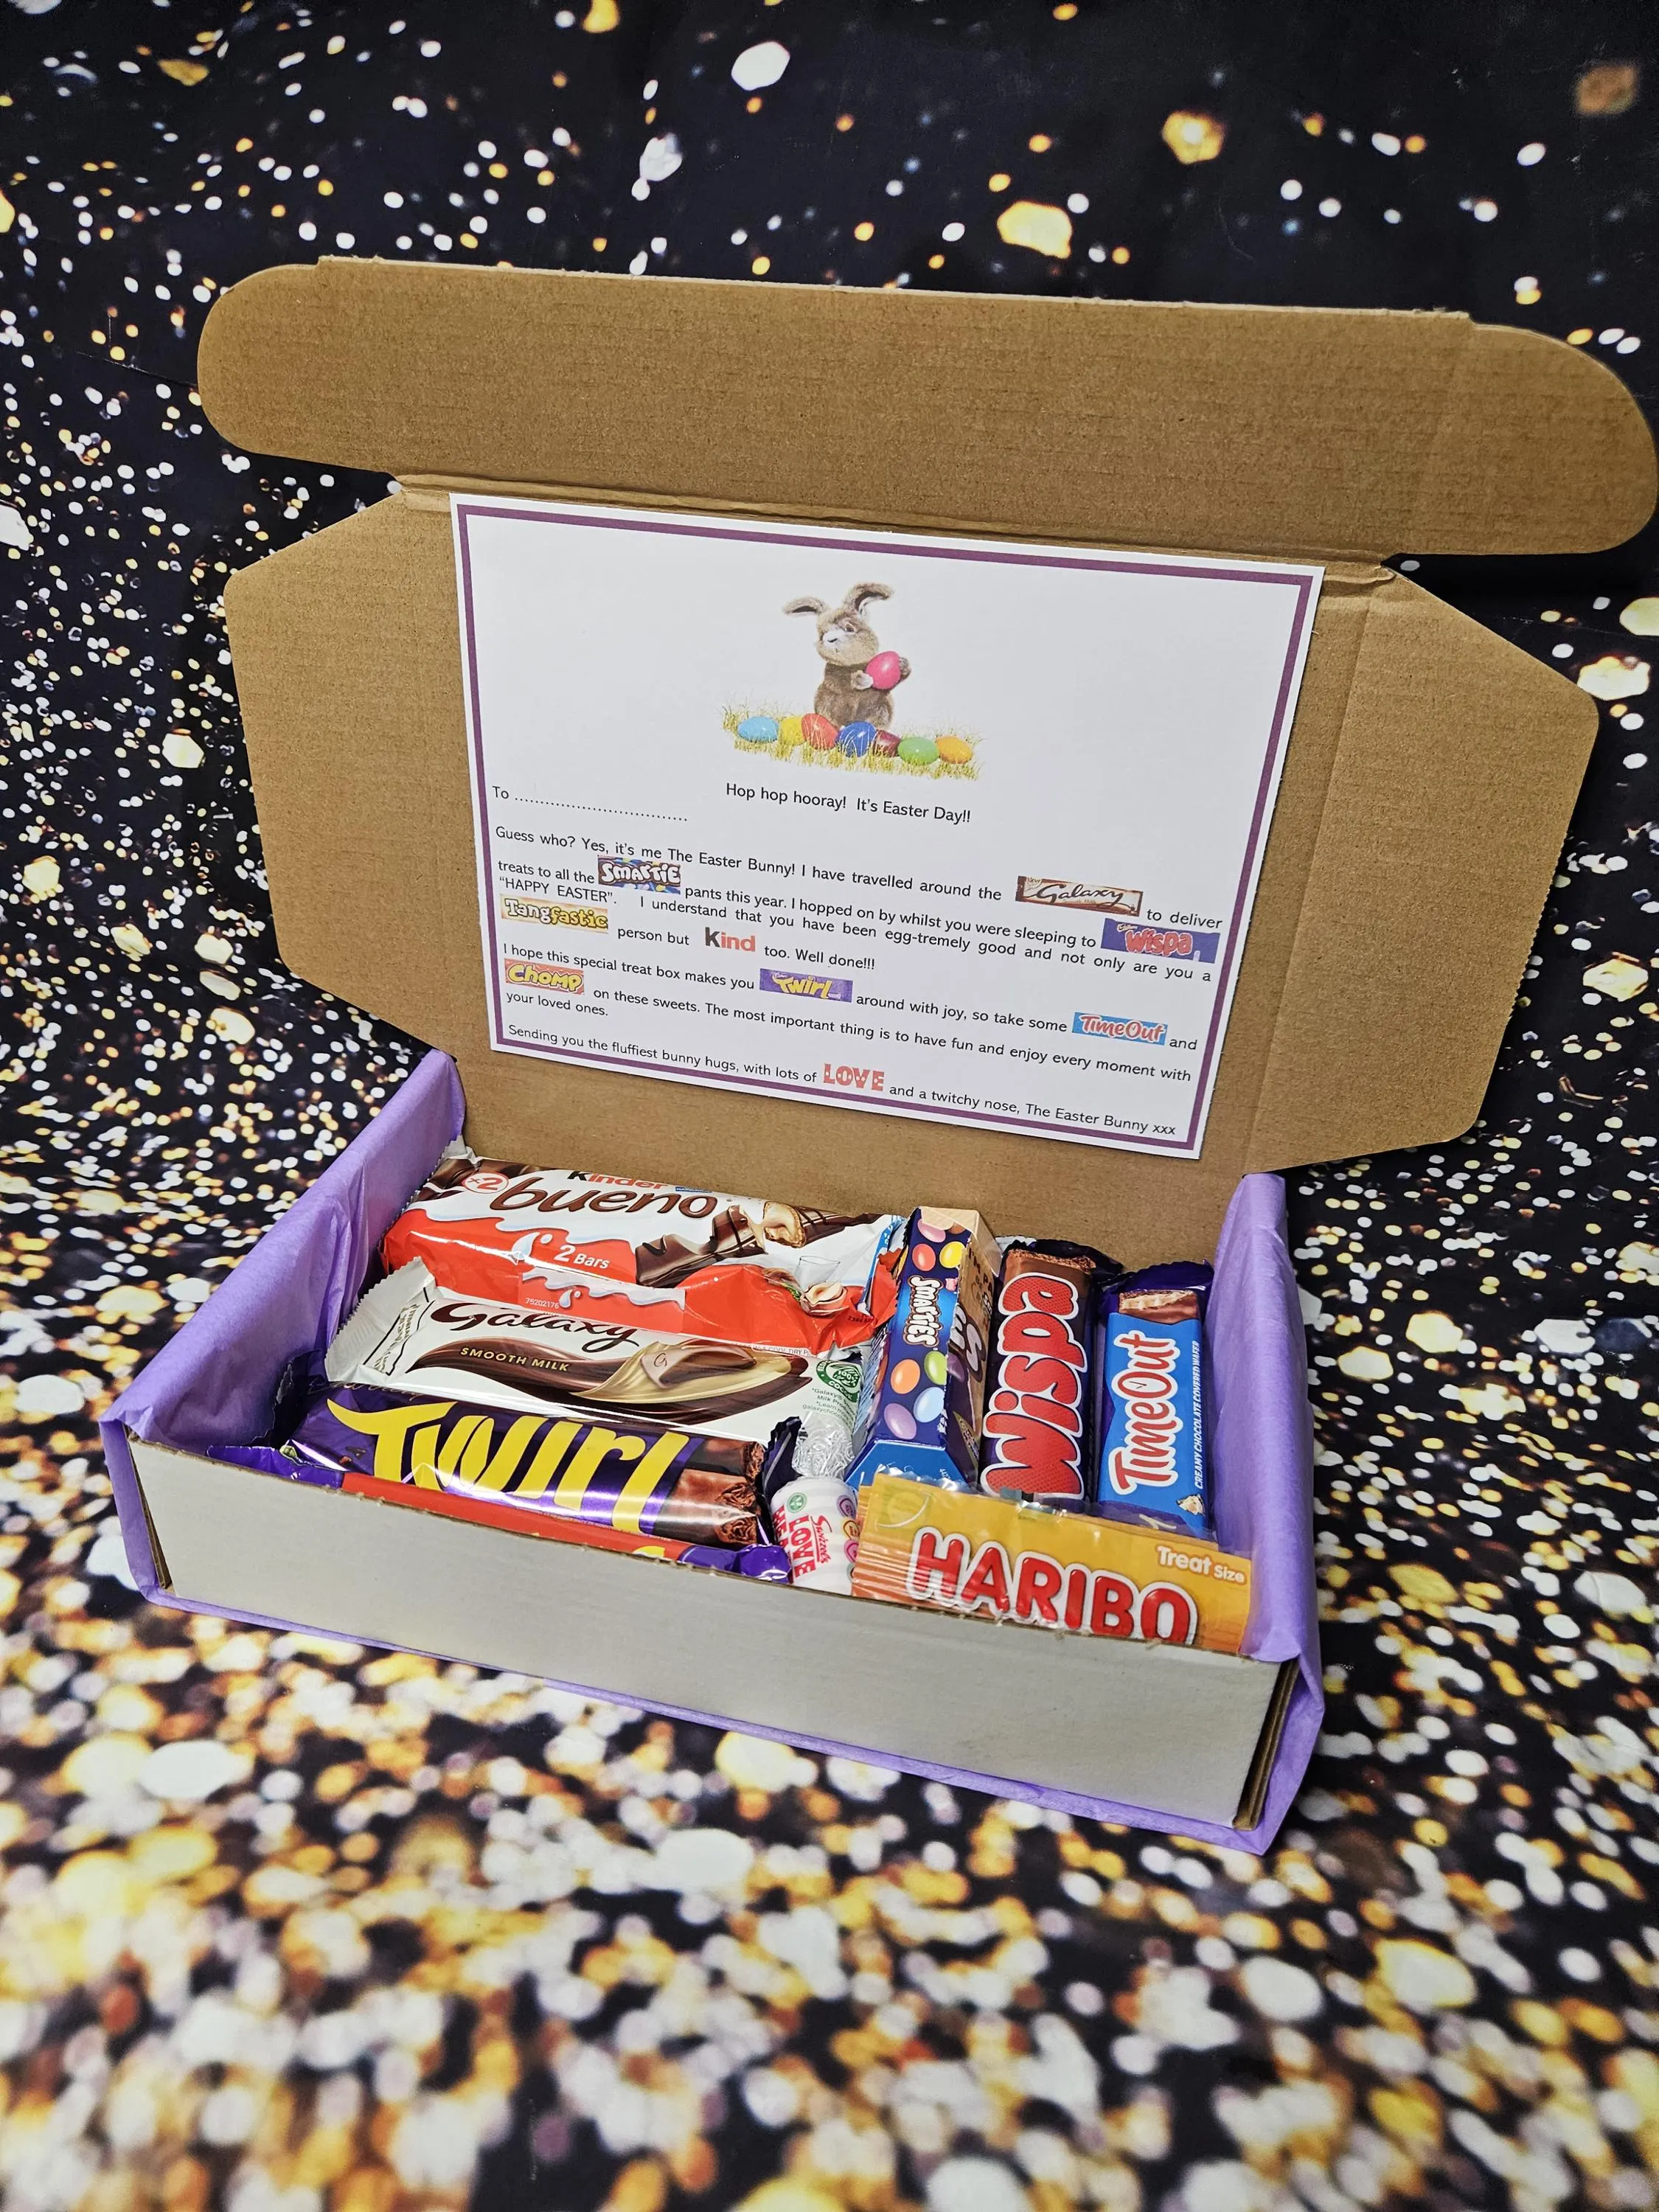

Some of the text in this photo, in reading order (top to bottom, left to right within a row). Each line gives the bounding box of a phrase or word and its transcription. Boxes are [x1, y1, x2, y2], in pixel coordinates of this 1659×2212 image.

[491, 785, 509, 799] To
[726, 782, 971, 826] Hop hop hooray! It's Easter Day!!
[495, 825, 1224, 929] Guess who? Yes, it's me The Easter Bunny! I have travelled around the Galaxy to deliver
[497, 860, 535, 876] treats
[537, 866, 552, 878] to
[554, 868, 570, 881] all
[573, 870, 596, 884] the
[685, 887, 722, 901] pants
[725, 889, 751, 904] this
[753, 895, 787, 909] year.
[791, 897, 796, 910] I
[799, 898, 852, 918] hopped
[856, 908, 874, 920] on
[878, 908, 897, 925] by
[899, 912, 942, 931] whilst
[945, 919, 972, 933] you
[975, 923, 1012, 937] were
[1014, 926, 1077, 949] sleeping
[1080, 935, 1097, 948] to
[1126, 929, 1192, 956] Wispa
[504, 898, 608, 929] Tangfastic
[617, 928, 662, 942] person
[667, 931, 690, 946] but
[764, 945, 790, 959] too.
[794, 947, 824, 964] Well
[827, 953, 875, 970] done!!!
[640, 895, 644, 908] I
[652, 900, 727, 919] understand
[734, 906, 763, 923] that
[769, 915, 795, 928] you
[802, 916, 835, 933] have
[842, 921, 877, 938] been
[884, 928, 972, 953] egg-tremely
[978, 942, 1017, 956] good
[1024, 947, 1053, 960] and
[1060, 953, 1086, 965] not
[1093, 956, 1126, 973] only
[1133, 962, 1158, 974] are
[1164, 967, 1194, 980] you
[1202, 972, 1211, 982] a
[504, 942, 507, 954] I
[511, 944, 543, 961] hope
[546, 950, 570, 964] this
[573, 956, 617, 971] special
[621, 961, 653, 976] treat
[656, 964, 681, 980] box
[684, 971, 726, 986] makes
[729, 978, 755, 990] you
[771, 973, 832, 999] Twirl
[855, 995, 905, 1011] around
[909, 1001, 939, 1015] with
[941, 1004, 967, 1021] joy,
[972, 1011, 989, 1022] so
[993, 1012, 1024, 1026] take
[1028, 1019, 1068, 1033] some
[1169, 1038, 1198, 1051] and
[505, 992, 608, 1017] your loved ones.
[593, 990, 610, 1000] on
[613, 990, 649, 1005] these
[652, 998, 700, 1013] sweets.
[704, 1002, 729, 1017] The
[733, 1009, 766, 1023] most
[770, 1012, 835, 1032] important
[839, 1022, 874, 1040] thing
[879, 1027, 891, 1040] is
[894, 1030, 910, 1043] to
[914, 1032, 947, 1048] have
[950, 1037, 973, 1051] fun
[978, 1043, 1005, 1056] and
[1009, 1047, 1048, 1065] enjoy
[1051, 1054, 1092, 1071] every
[1096, 1060, 1156, 1077] moment
[1160, 1068, 1192, 1082] with
[508, 1024, 1176, 1135] Sending you the fluffiest bunny hugs, with lots of LOVE and a twitchy nose, The Easter Bunny xxx
[490, 1176, 718, 1219] bueno
[554, 1244, 577, 1262] 2
[431, 1301, 639, 1354] Galaxy
[524, 1297, 560, 1310] 75202176
[460, 1346, 570, 1372] SMOOTH MILK
[982, 1273, 1086, 1498] Wispa
[1192, 1340, 1204, 1490] CREAMY CHOCOLATE COVERED WAFER
[327, 1399, 689, 1534] Twirl
[788, 1514, 816, 1578] LOVE
[1157, 1546, 1245, 1585] Treat Size
[911, 1529, 1193, 1645] HARIBO
